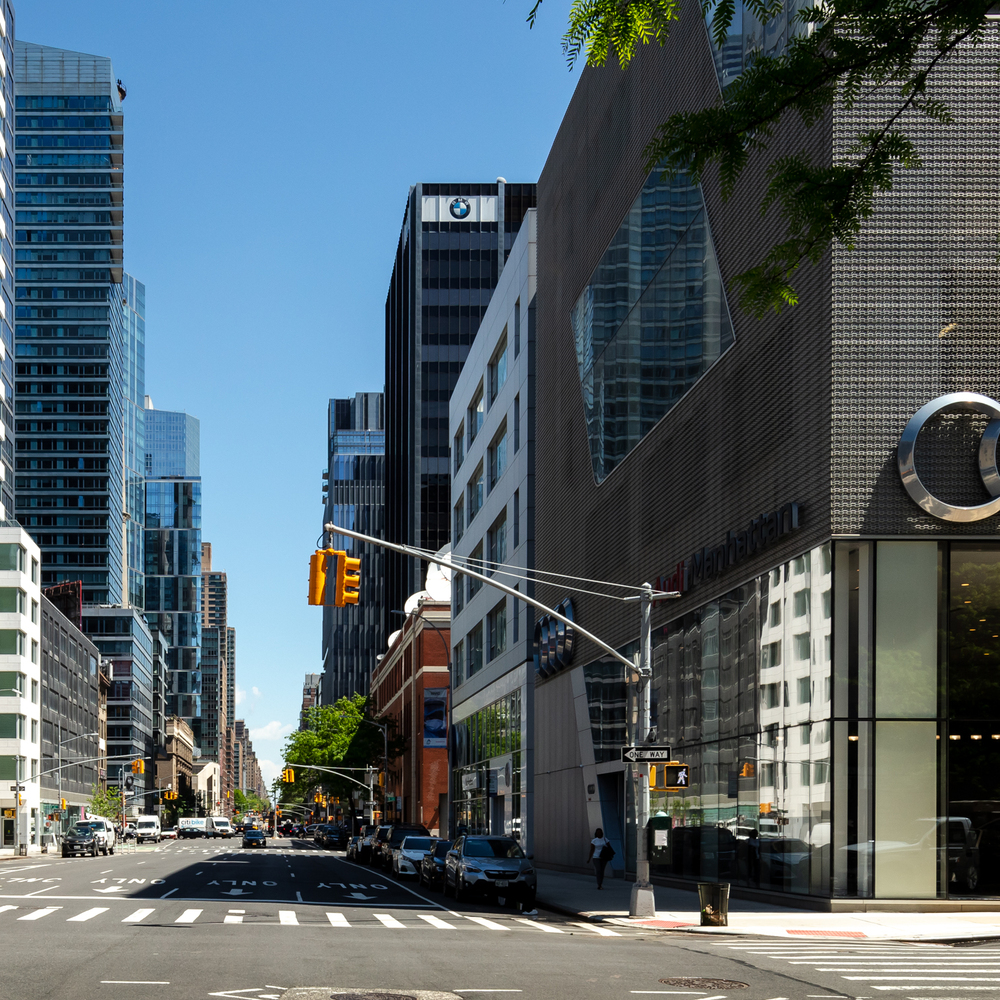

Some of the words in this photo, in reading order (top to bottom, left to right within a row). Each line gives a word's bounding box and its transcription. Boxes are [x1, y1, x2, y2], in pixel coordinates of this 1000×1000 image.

[652, 560, 686, 608] Audi
[691, 502, 799, 585] Manhattan
[90, 877, 166, 885] ONLY
[317, 882, 389, 890] ONLY
